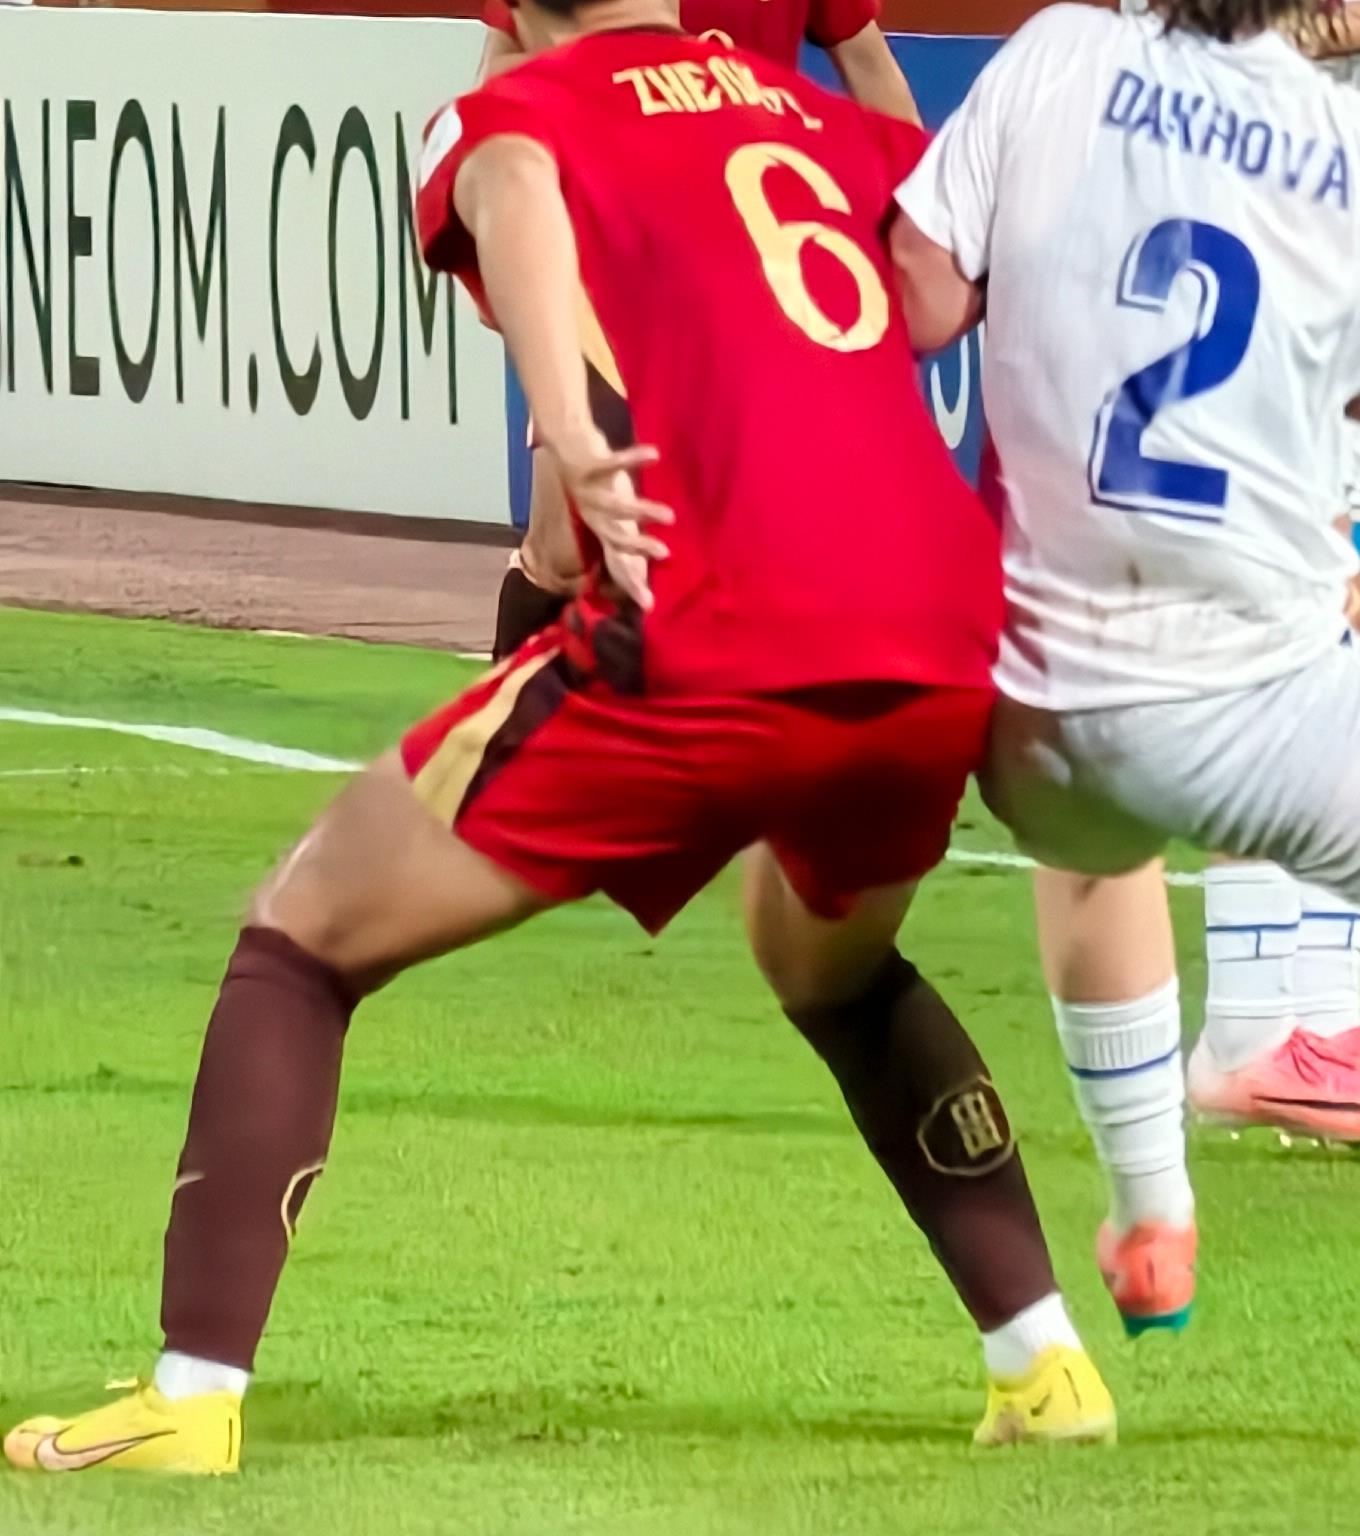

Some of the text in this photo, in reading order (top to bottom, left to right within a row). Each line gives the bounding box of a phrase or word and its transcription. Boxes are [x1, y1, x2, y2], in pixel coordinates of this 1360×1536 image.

[4, 98, 458, 425] NEOM.COM
[724, 141, 890, 353] 6
[1090, 219, 1261, 522] 2
